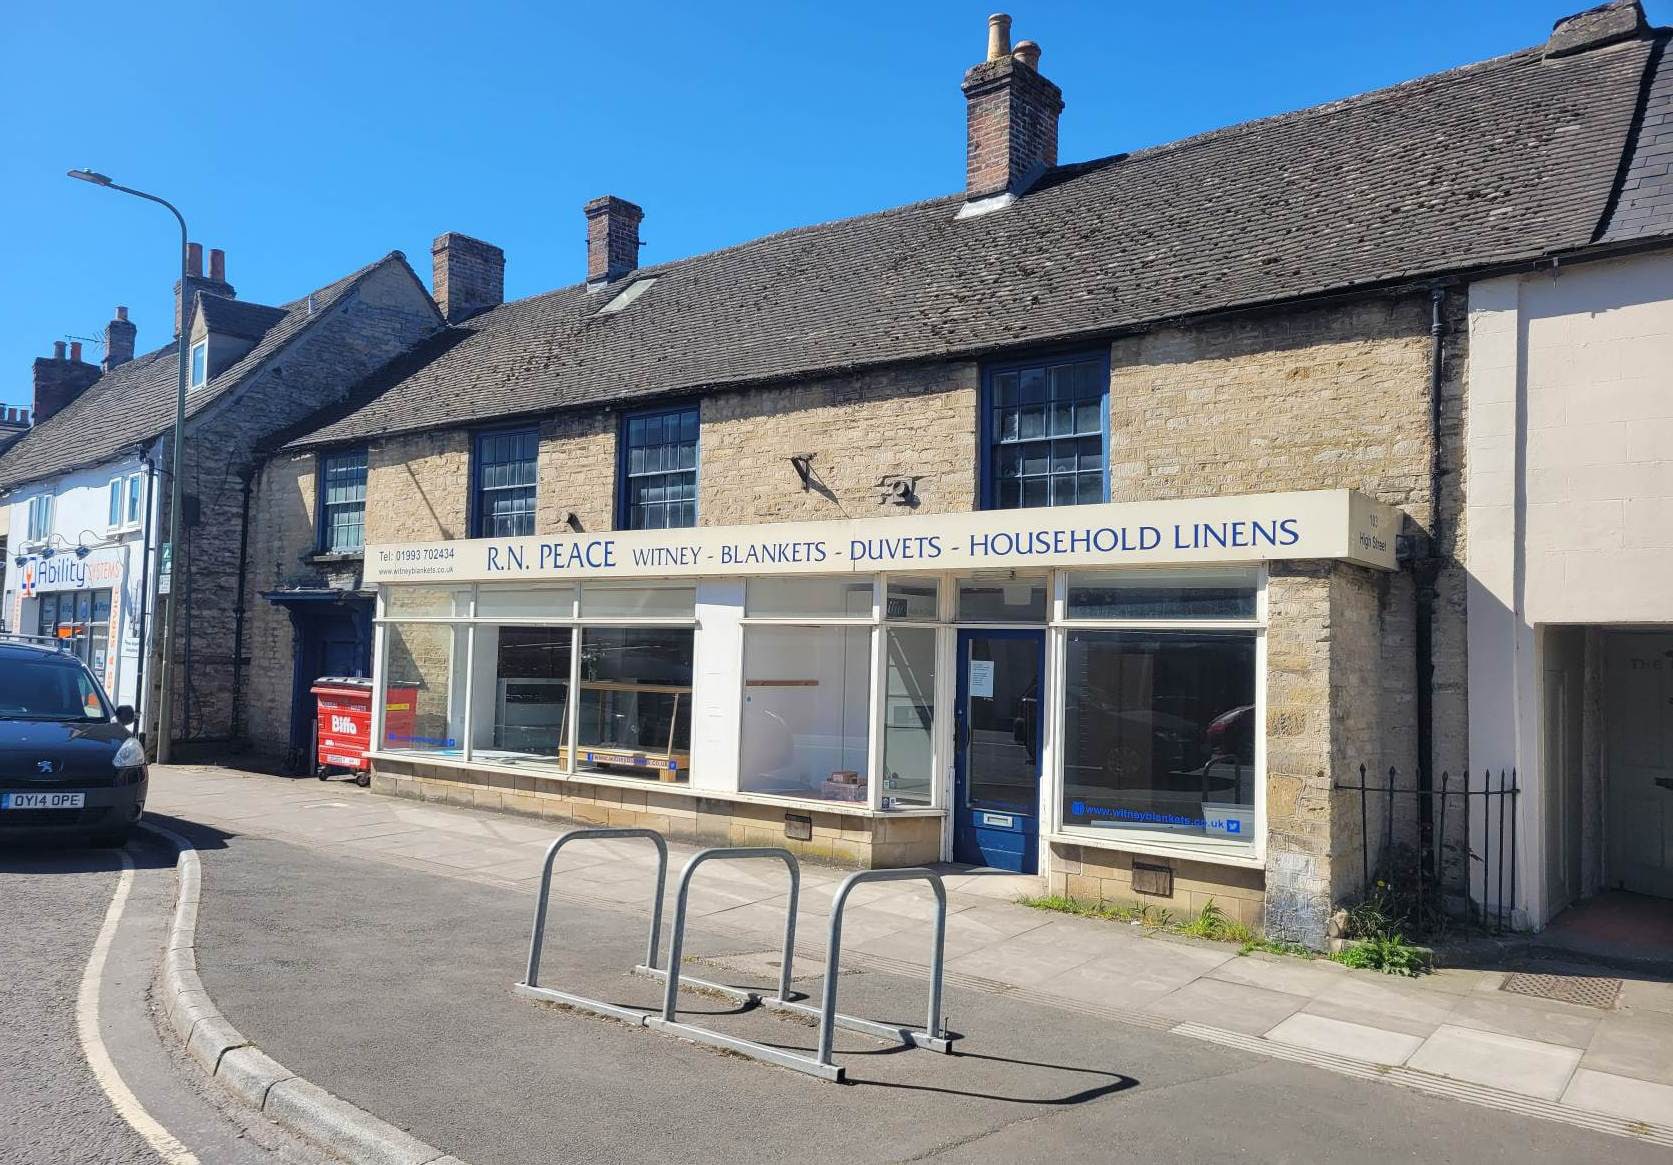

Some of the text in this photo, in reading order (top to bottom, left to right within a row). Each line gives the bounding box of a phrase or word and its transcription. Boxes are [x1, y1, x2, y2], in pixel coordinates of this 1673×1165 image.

[487, 545, 530, 571] R.N.
[540, 540, 617, 569] PEACE
[632, 546, 702, 567] WITNEY
[721, 541, 827, 564] BLANKETS
[850, 536, 941, 561] DUVETS
[970, 526, 1162, 556] HOUSEHOLD
[1174, 518, 1300, 549] LINENS
[379, 548, 455, 562] Tel: 01993 702434
[38, 557, 86, 588] Ability
[378, 566, 454, 576] www.witneyblankets.co.uk
[331, 714, 357, 734] Biffa
[15, 794, 80, 807] OY14 OPE
[1086, 805, 1224, 829] www.witneyblankets.co.uk
